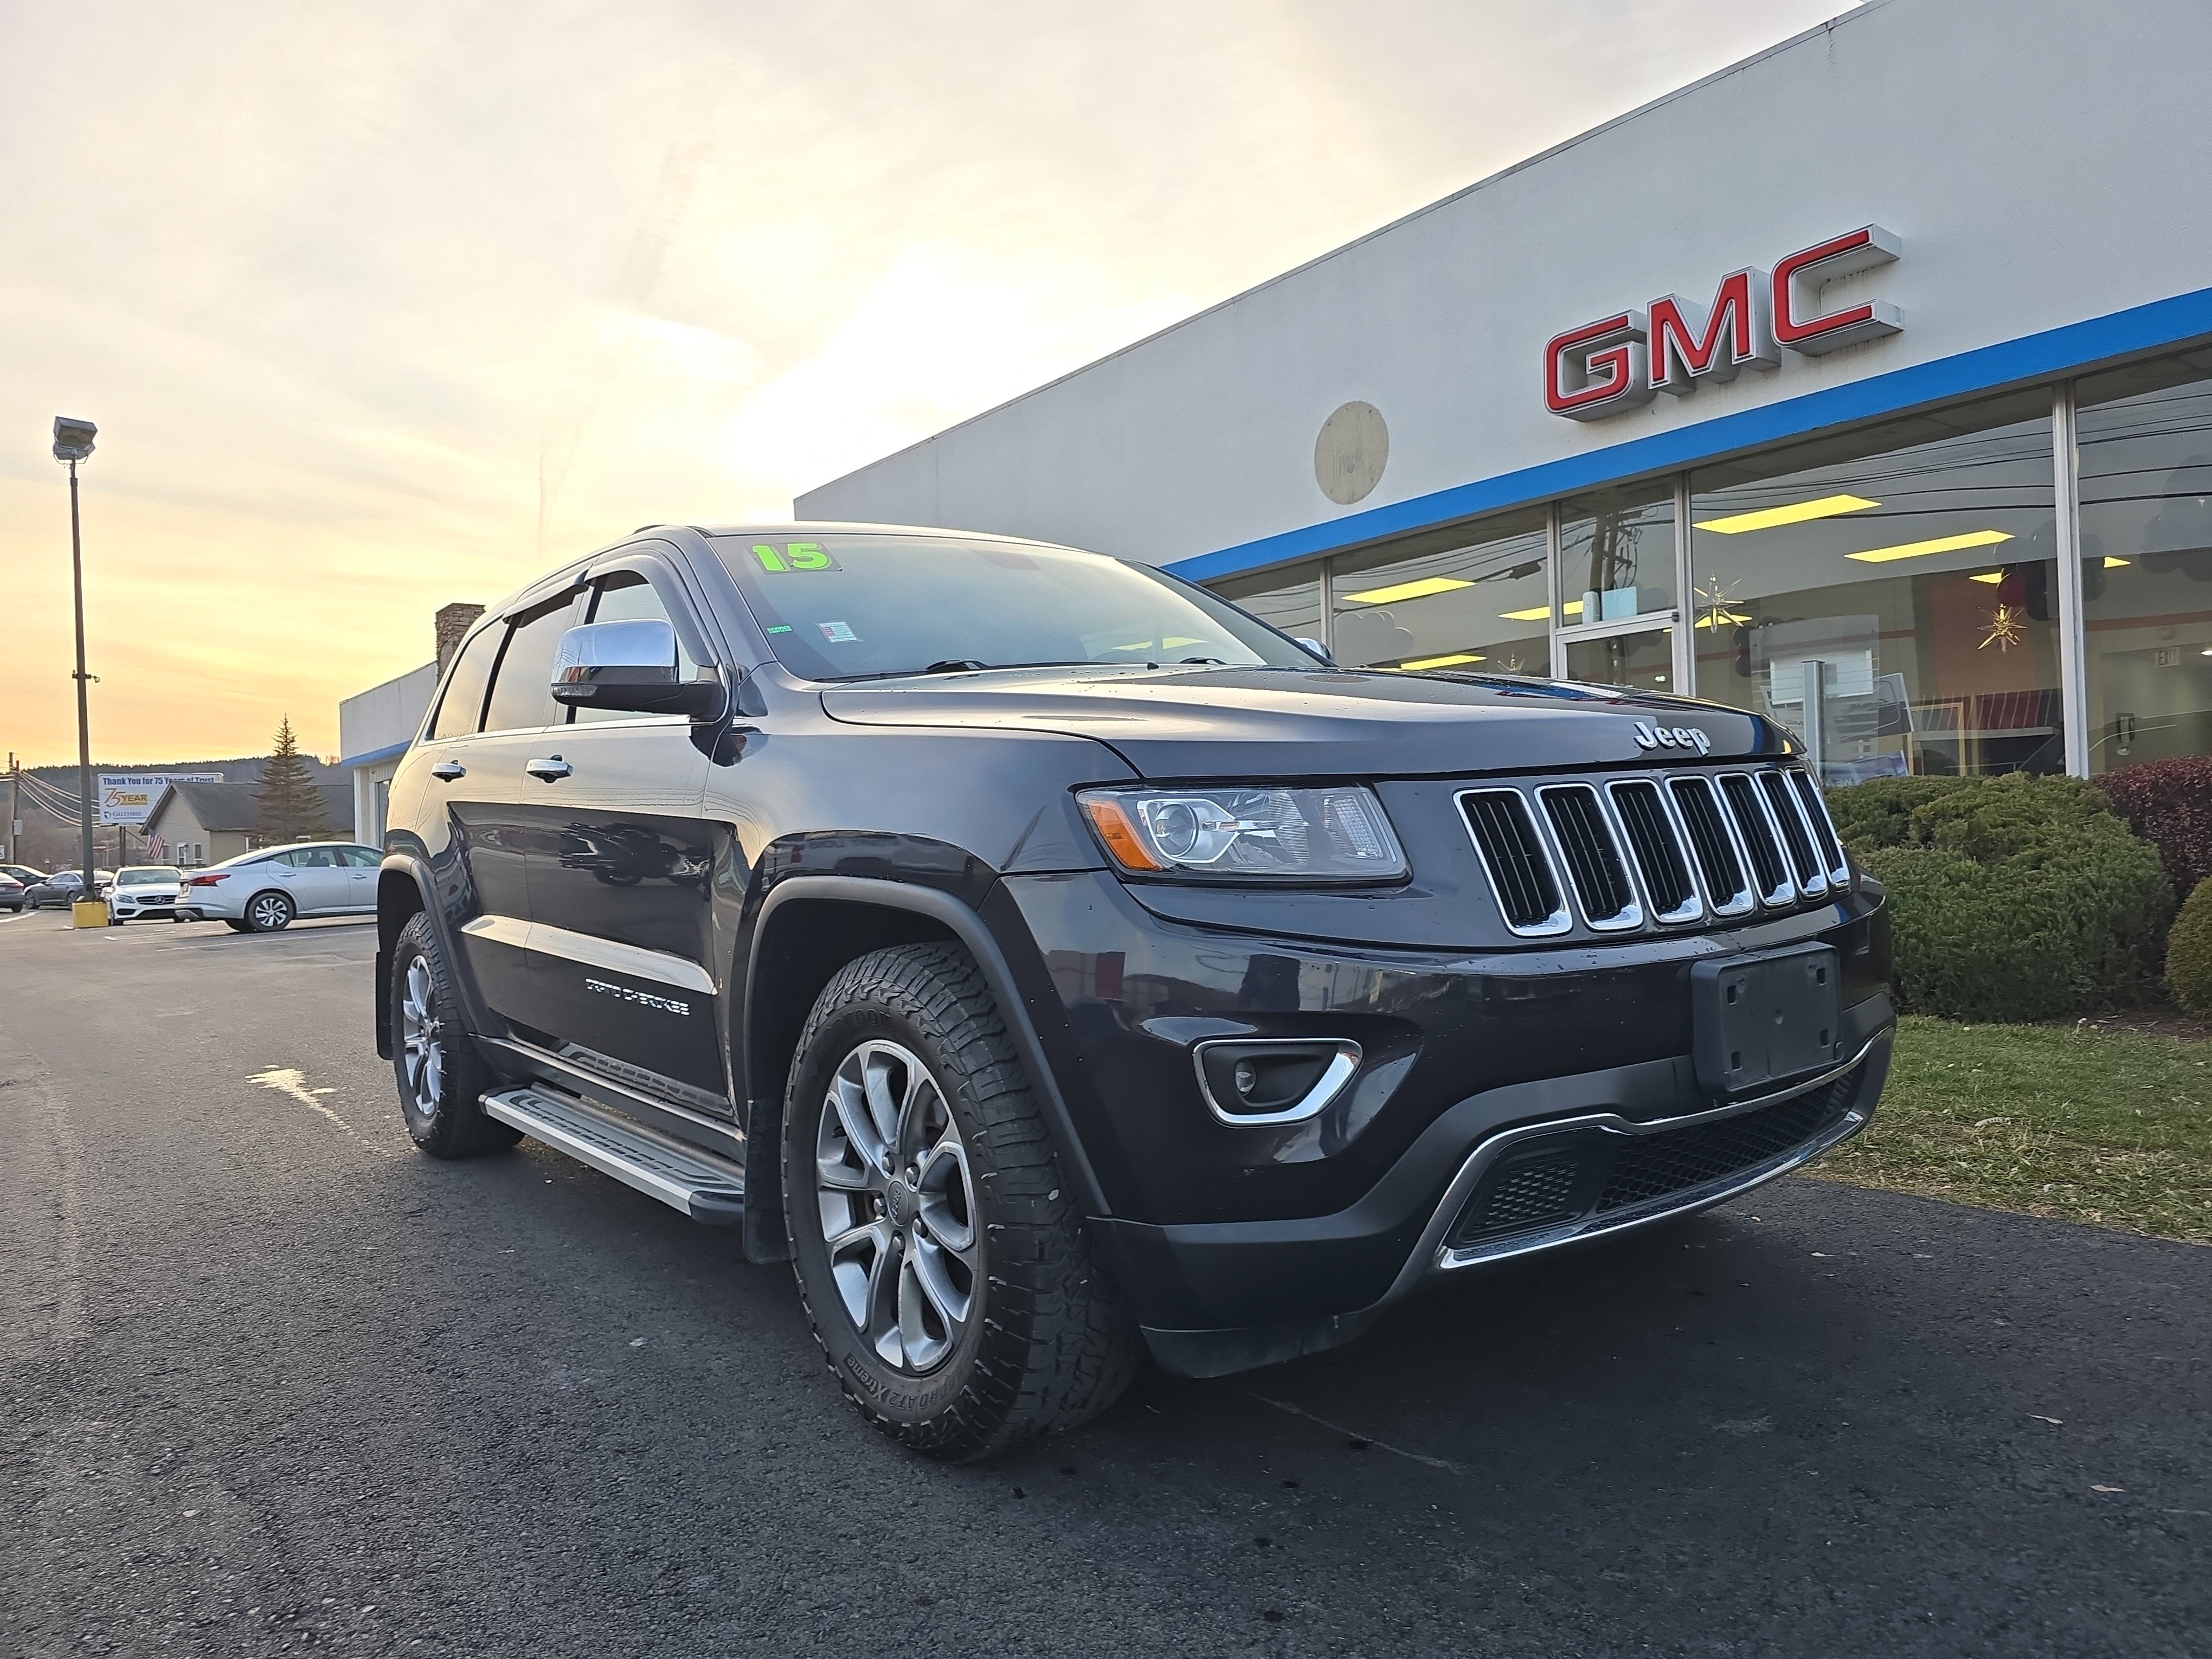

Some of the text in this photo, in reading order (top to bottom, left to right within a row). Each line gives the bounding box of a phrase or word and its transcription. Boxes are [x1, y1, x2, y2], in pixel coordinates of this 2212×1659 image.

[1544, 223, 1887, 416] GMC
[752, 543, 831, 571] 15
[1633, 721, 1711, 756] Jeep
[103, 777, 126, 785] Thank
[127, 777, 140, 785] You
[142, 777, 153, 785] for
[155, 777, 163, 785] 75
[104, 788, 126, 807] 75
[847, 1356, 888, 1403] Xtreme
